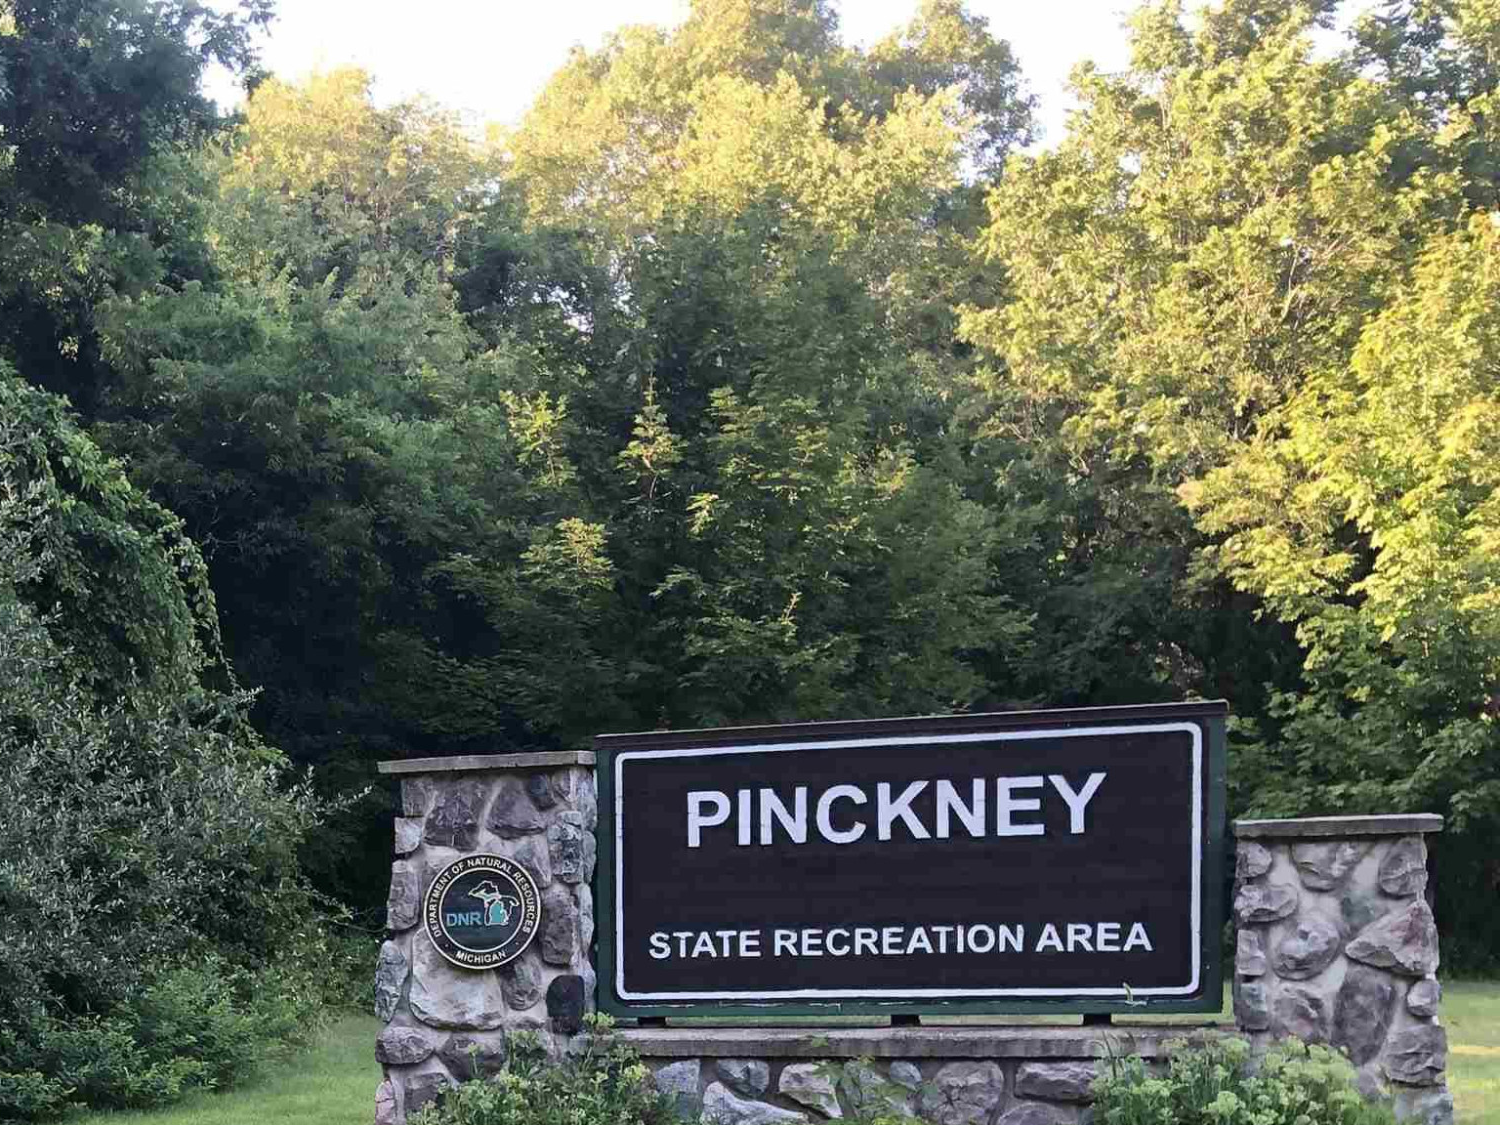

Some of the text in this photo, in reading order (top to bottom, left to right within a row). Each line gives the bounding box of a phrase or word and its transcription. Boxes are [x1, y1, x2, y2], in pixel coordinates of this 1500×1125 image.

[687, 772, 1107, 848] PINCKNEY
[428, 857, 536, 938] DEPARTMENT OF NATURAL RESOURCES
[446, 911, 482, 927] DNR
[454, 950, 508, 964] MICHIGAN
[649, 922, 1153, 959] STATE RECREATION AREA
